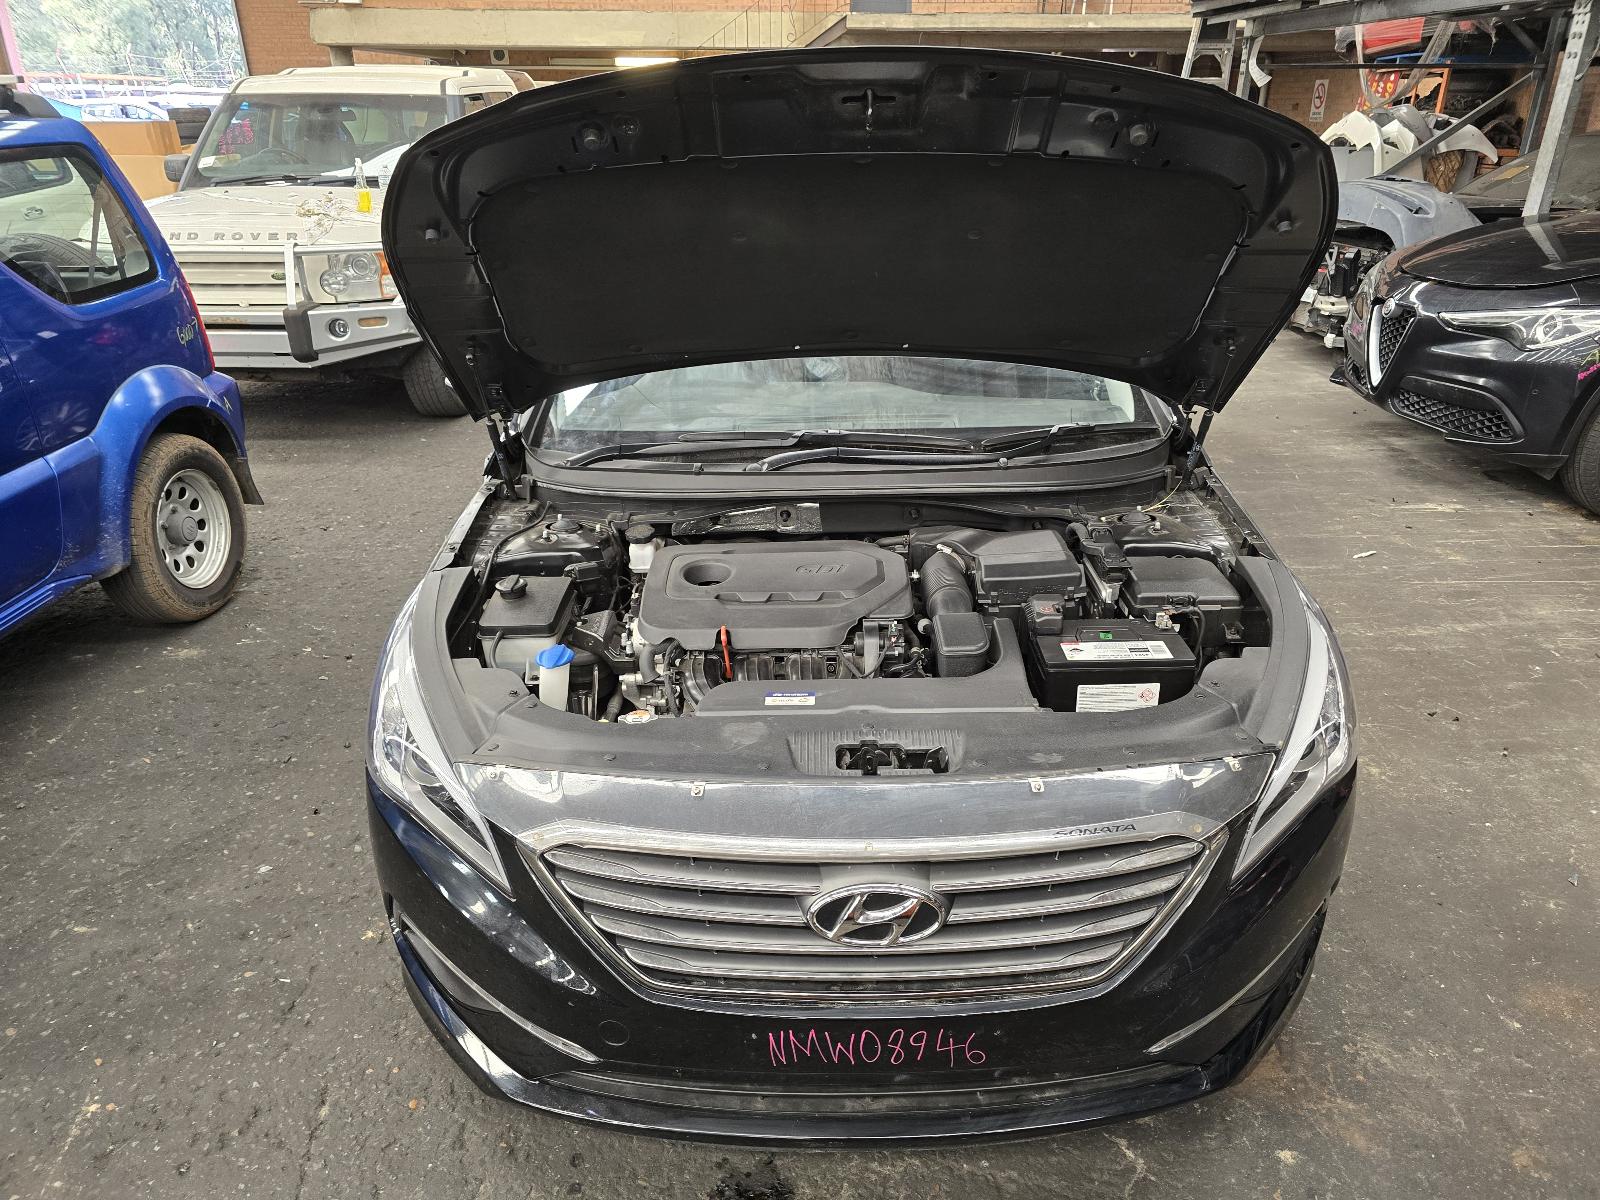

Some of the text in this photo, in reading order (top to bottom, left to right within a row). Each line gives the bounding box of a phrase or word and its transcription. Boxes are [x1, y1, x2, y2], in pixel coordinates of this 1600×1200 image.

[169, 231, 298, 241] ND ROVER
[1053, 823, 1137, 838] SONATA
[768, 1028, 986, 1068] NMW08946
